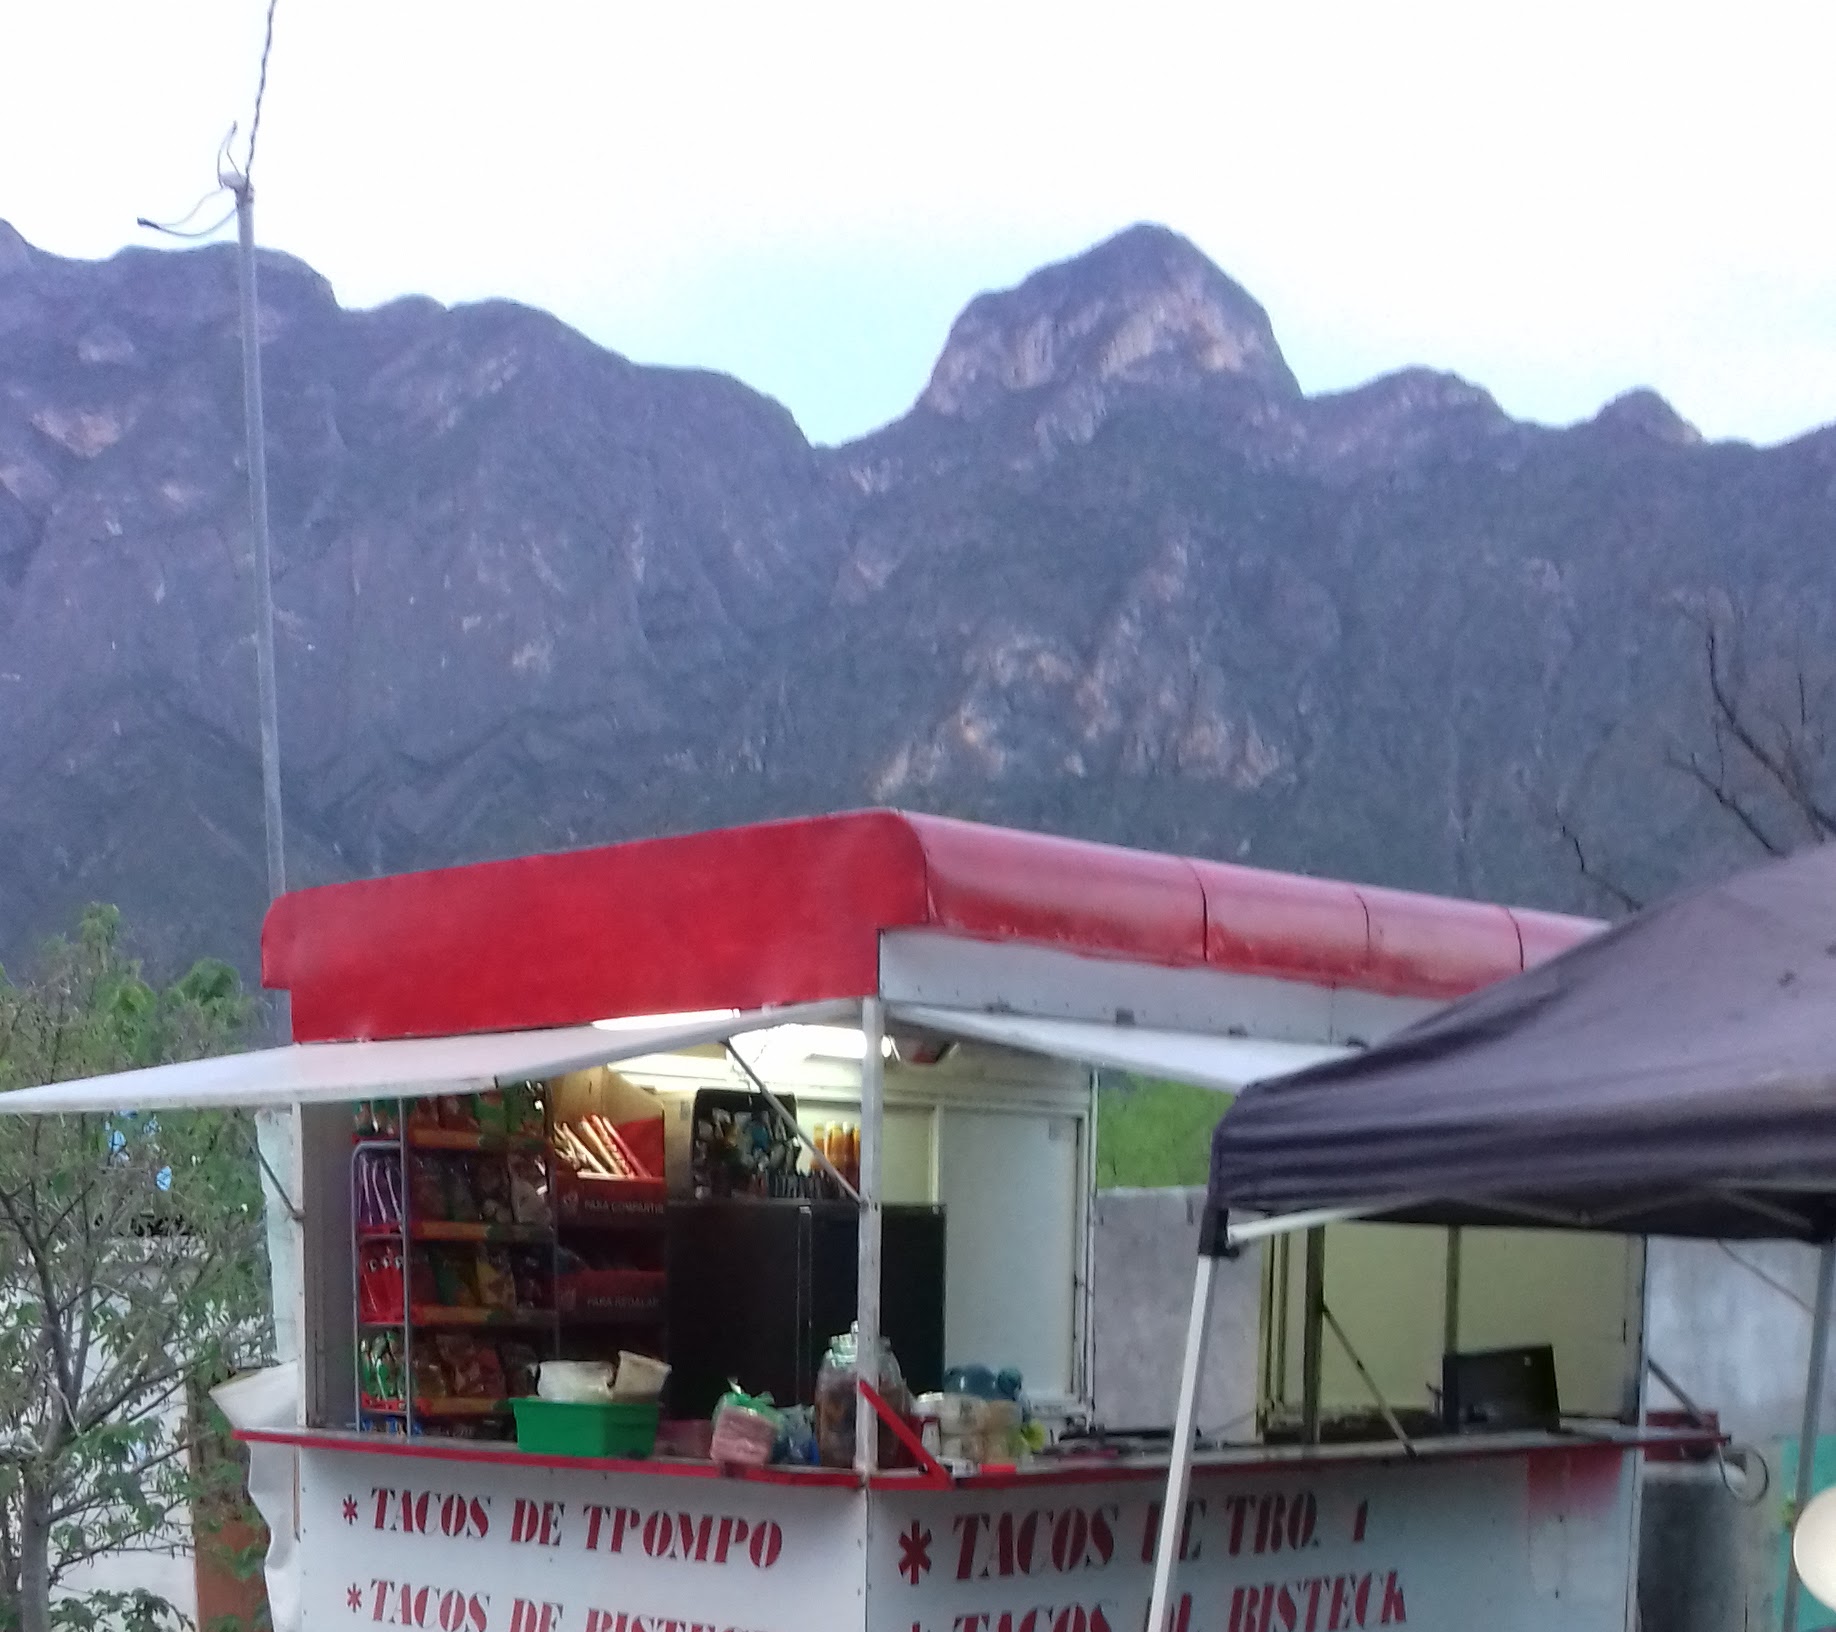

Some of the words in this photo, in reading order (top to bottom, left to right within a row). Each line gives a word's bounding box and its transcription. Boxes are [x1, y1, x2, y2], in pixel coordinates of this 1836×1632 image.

[584, 1200, 608, 1211] PARA
[371, 1487, 491, 1539] TACOS
[511, 1498, 565, 1548] DE
[953, 1503, 1119, 1580] TACOS
